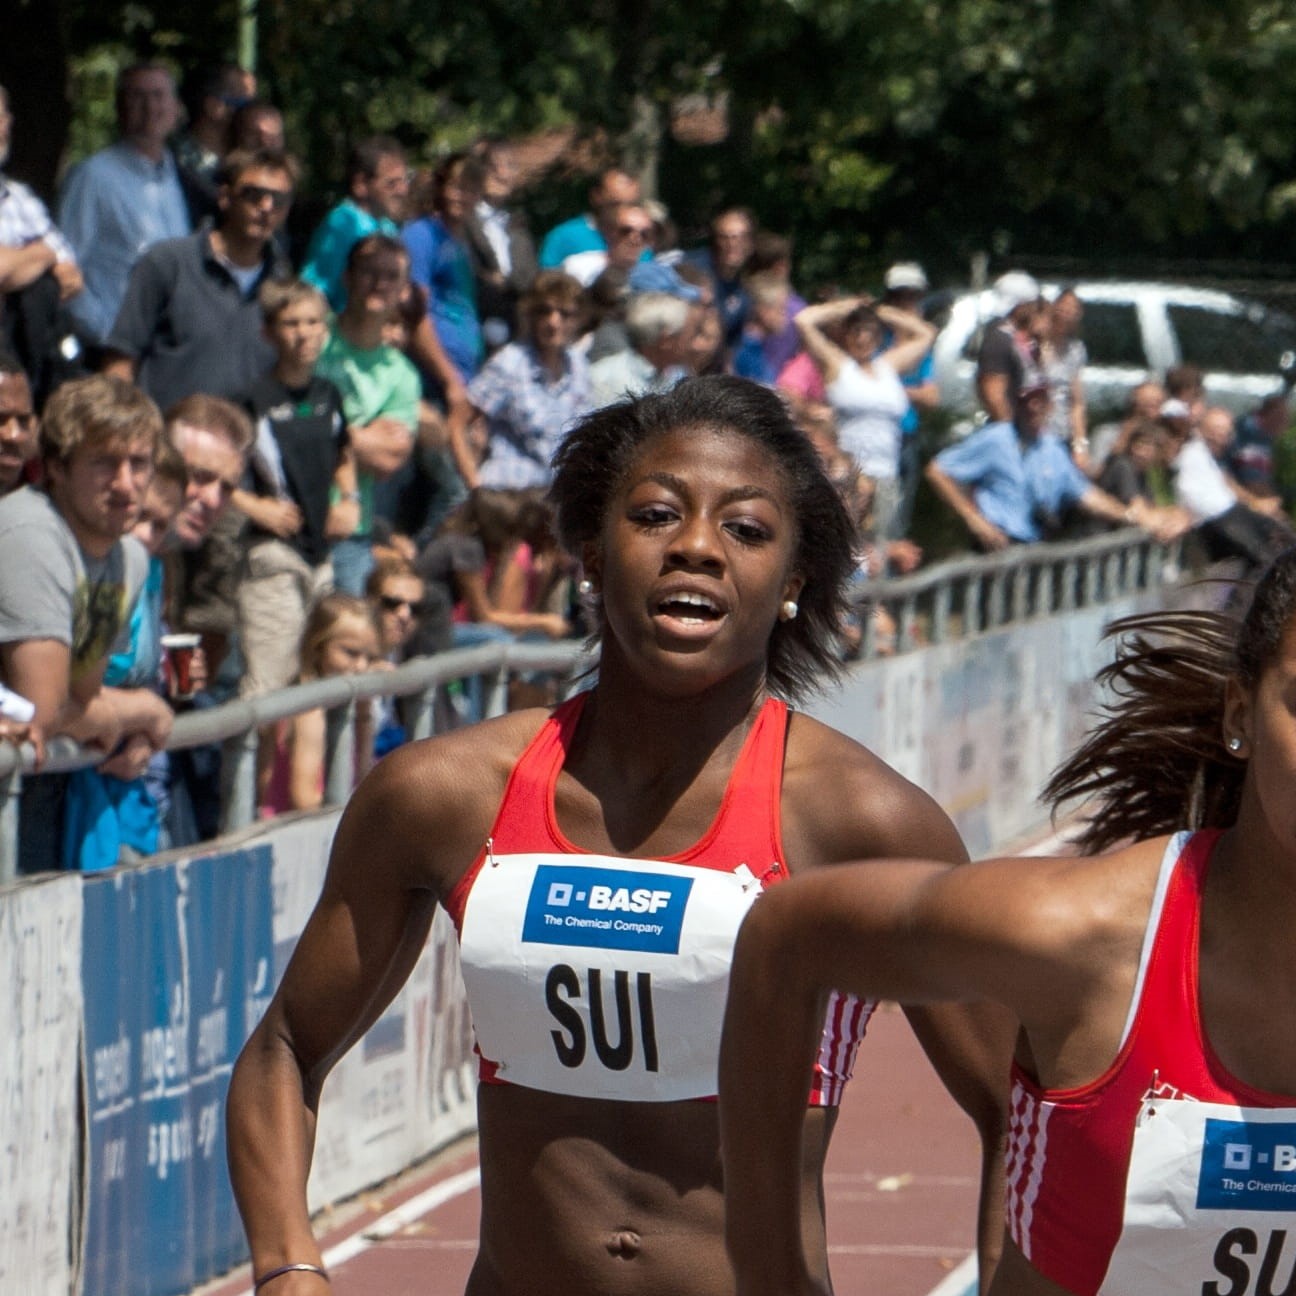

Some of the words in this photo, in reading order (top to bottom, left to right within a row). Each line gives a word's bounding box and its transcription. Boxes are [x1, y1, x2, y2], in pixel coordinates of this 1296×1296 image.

[588, 885, 672, 914] BASF
[543, 914, 563, 926] The
[565, 915, 613, 930] Chemical
[613, 919, 664, 936] Company
[545, 963, 659, 1073] SUI
[1221, 1178, 1245, 1191] The
